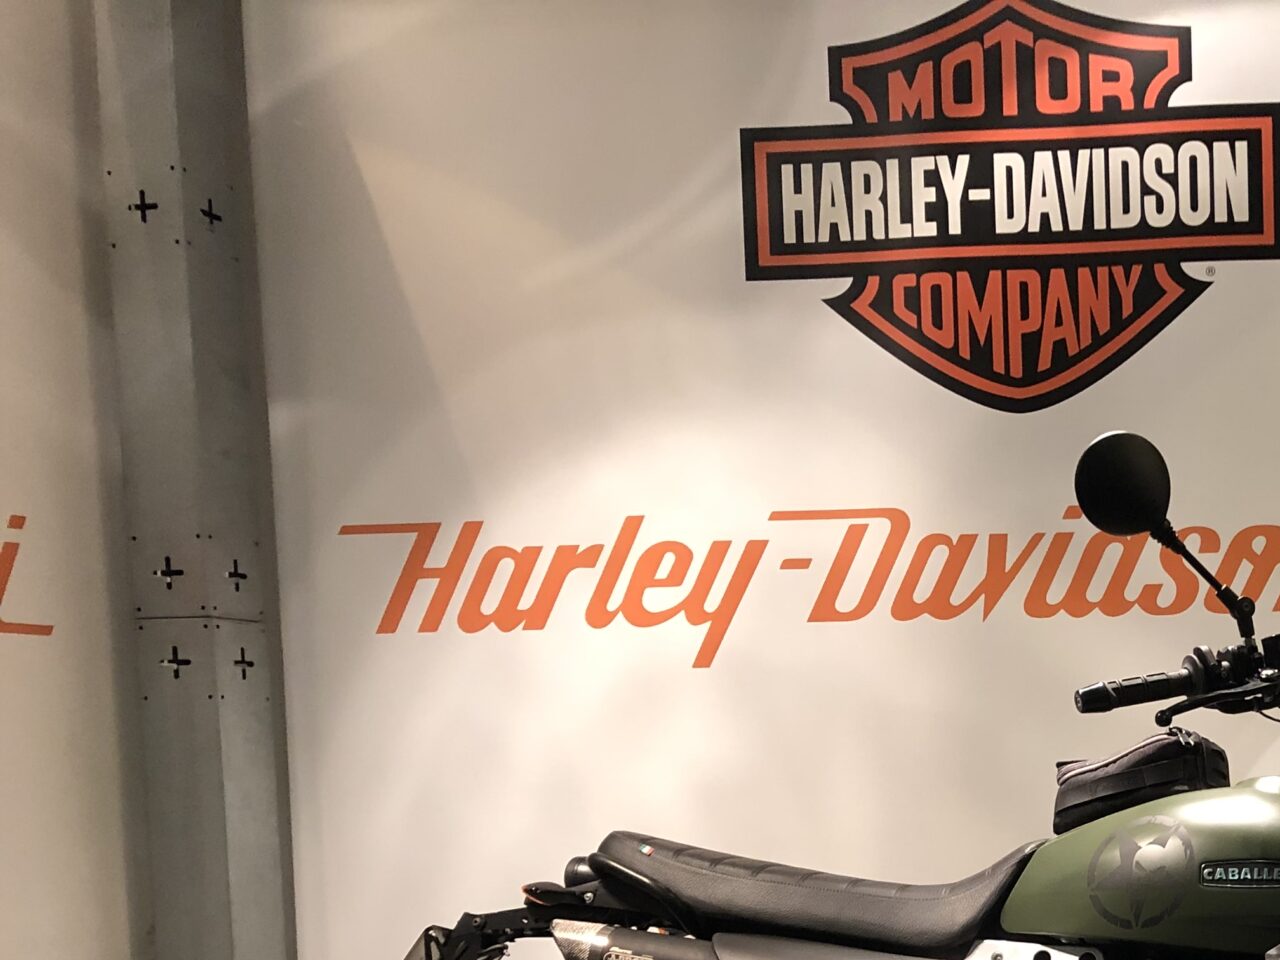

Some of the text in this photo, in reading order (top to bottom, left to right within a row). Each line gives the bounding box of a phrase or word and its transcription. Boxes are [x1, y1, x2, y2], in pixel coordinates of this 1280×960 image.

[887, 19, 1135, 121] MOTOR
[780, 141, 1250, 244] HARLEY-DAVIDSON
[892, 263, 1142, 378] COMPANY
